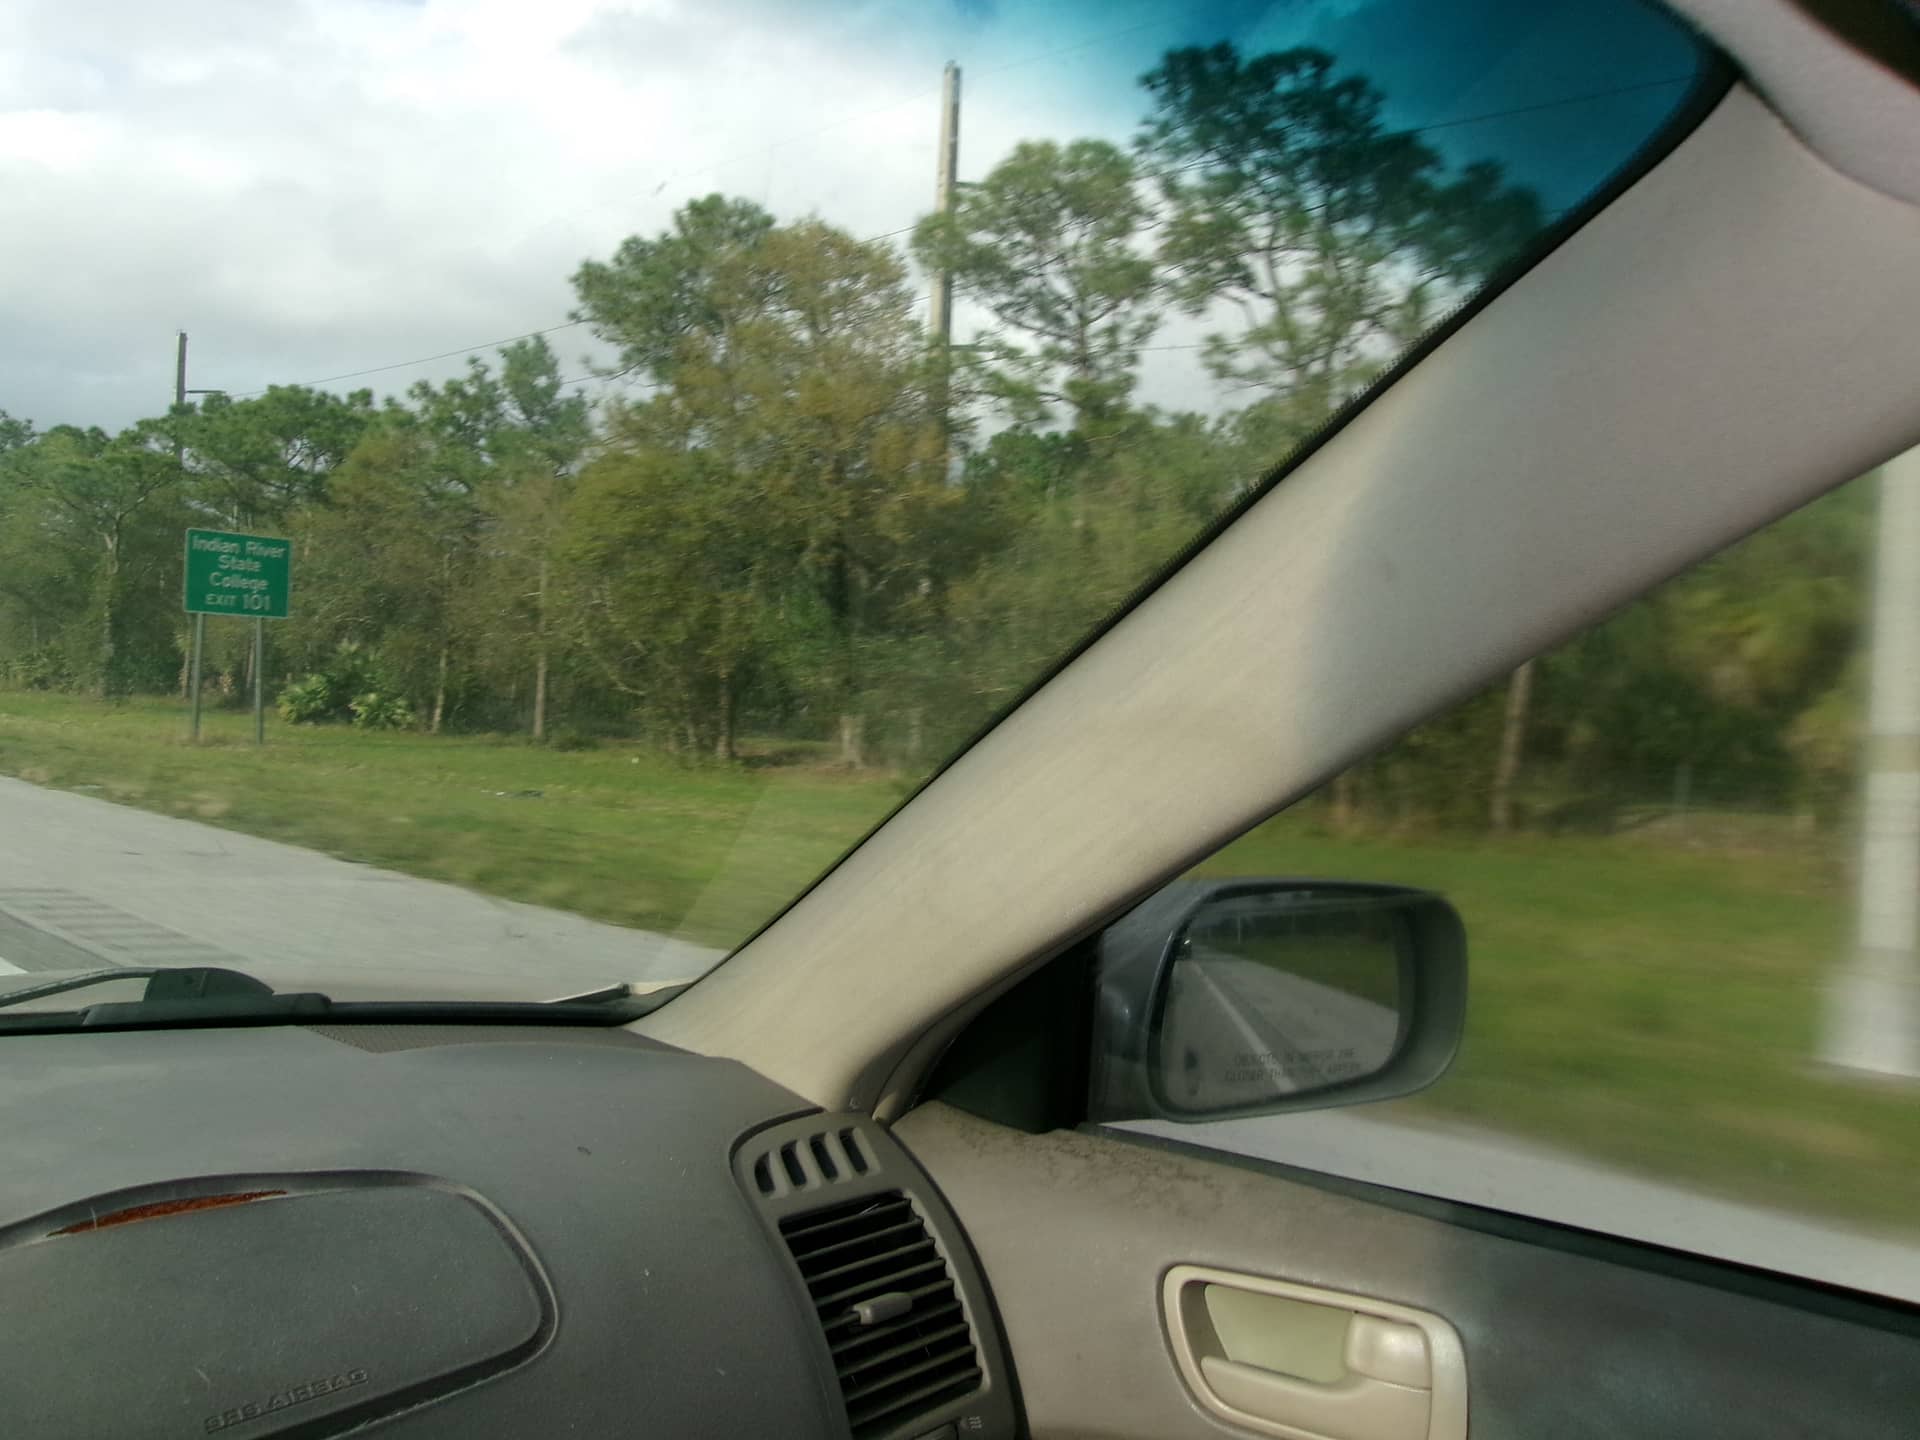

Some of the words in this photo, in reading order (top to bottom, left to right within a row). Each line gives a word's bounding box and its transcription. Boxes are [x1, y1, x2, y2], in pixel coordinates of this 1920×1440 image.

[193, 535, 240, 553] Indian
[246, 542, 286, 558] River
[218, 555, 261, 571] State
[210, 572, 268, 593] College
[206, 594, 236, 606] EXIT
[243, 595, 270, 610] 101
[270, 1369, 368, 1407] AIRBAG
